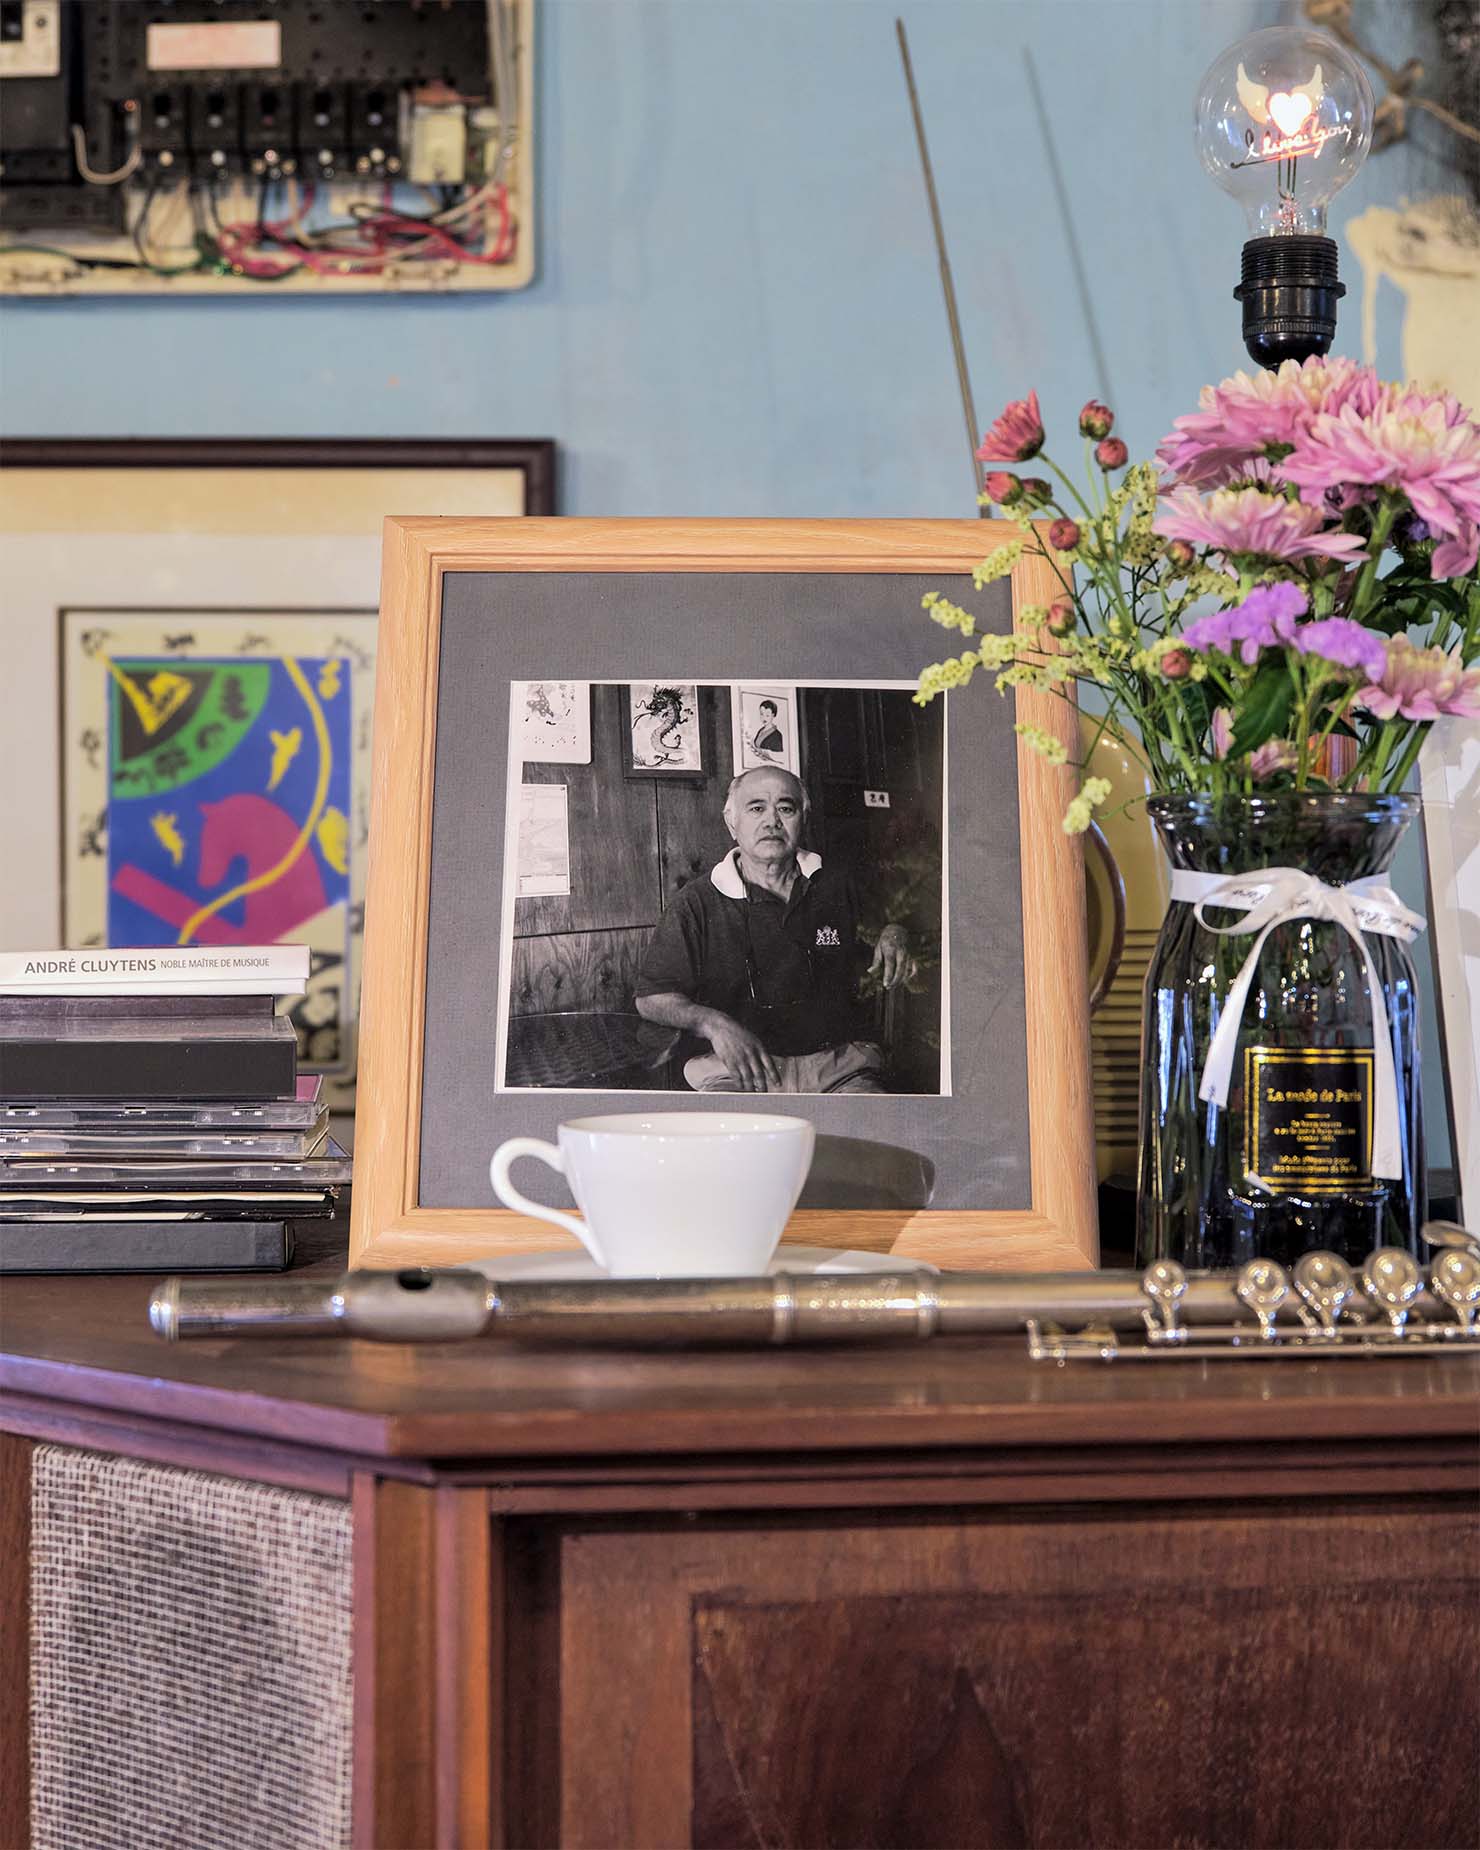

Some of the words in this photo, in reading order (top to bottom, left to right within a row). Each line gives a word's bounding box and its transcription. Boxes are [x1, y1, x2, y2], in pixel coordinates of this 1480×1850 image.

[24, 958, 77, 974] ANDRÉ
[81, 959, 157, 973] CLUYTENS
[160, 959, 187, 969] NOBLE
[188, 957, 219, 968] MAÎTRE
[220, 958, 232, 968] DE
[232, 957, 270, 968] MUSIQUE
[1320, 1088, 1334, 1103] de
[1335, 1088, 1362, 1103] Paris
